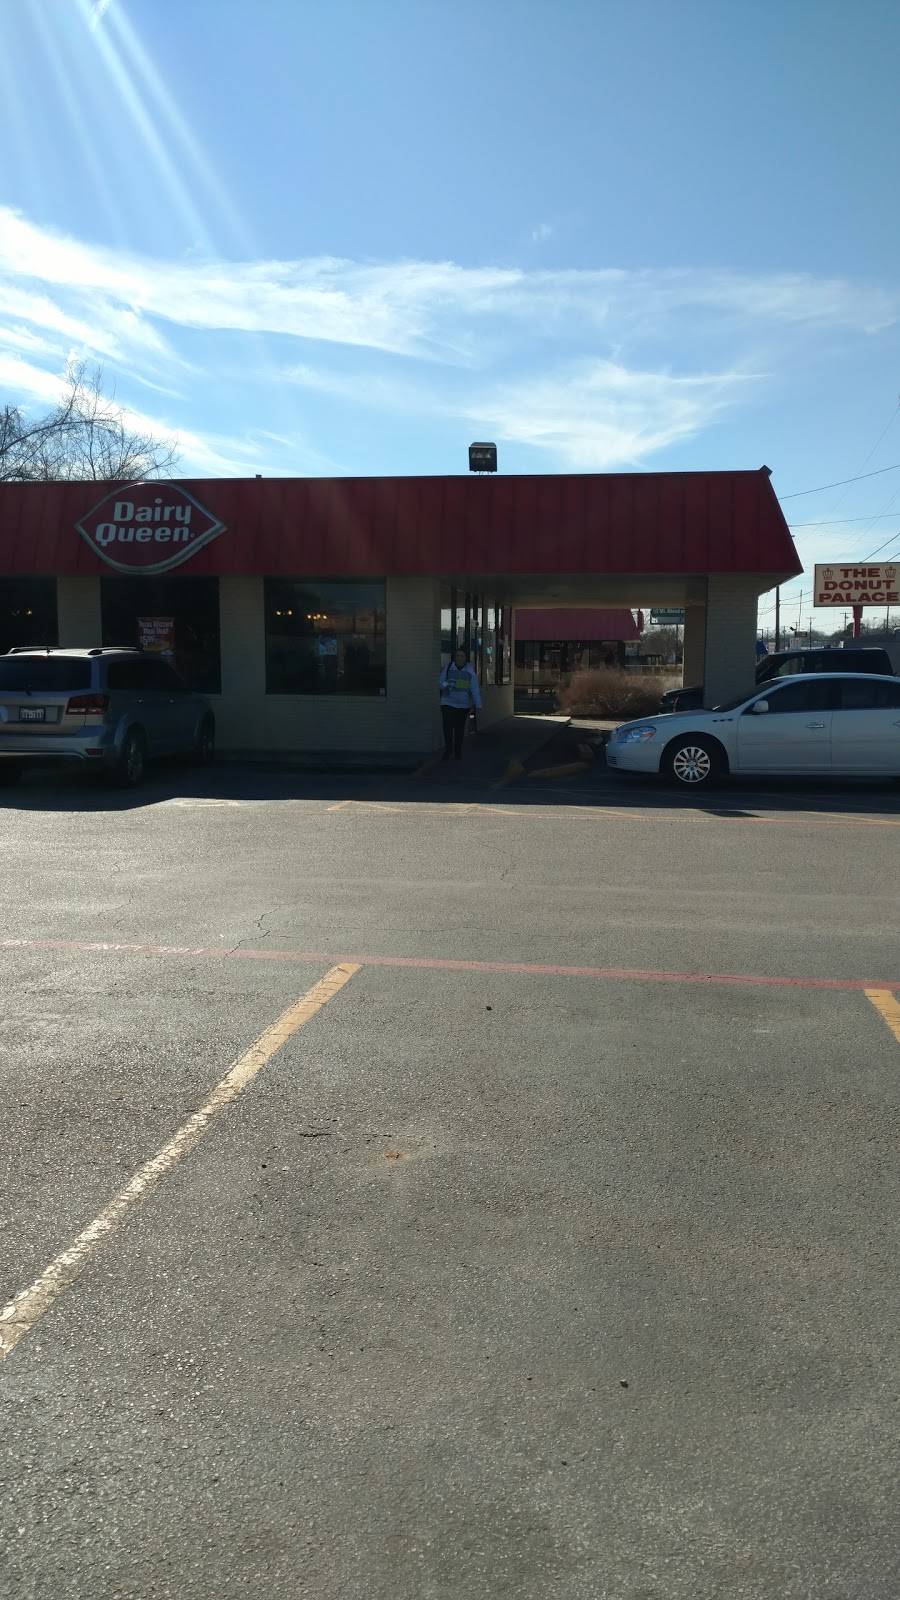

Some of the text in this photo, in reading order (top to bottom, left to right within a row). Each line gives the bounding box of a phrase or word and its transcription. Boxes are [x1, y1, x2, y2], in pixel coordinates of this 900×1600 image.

[113, 498, 192, 524] Dairy
[95, 523, 190, 546] Queen
[840, 568, 880, 578] THE
[824, 580, 895, 590] DONUT
[819, 592, 900, 602] PALACE
